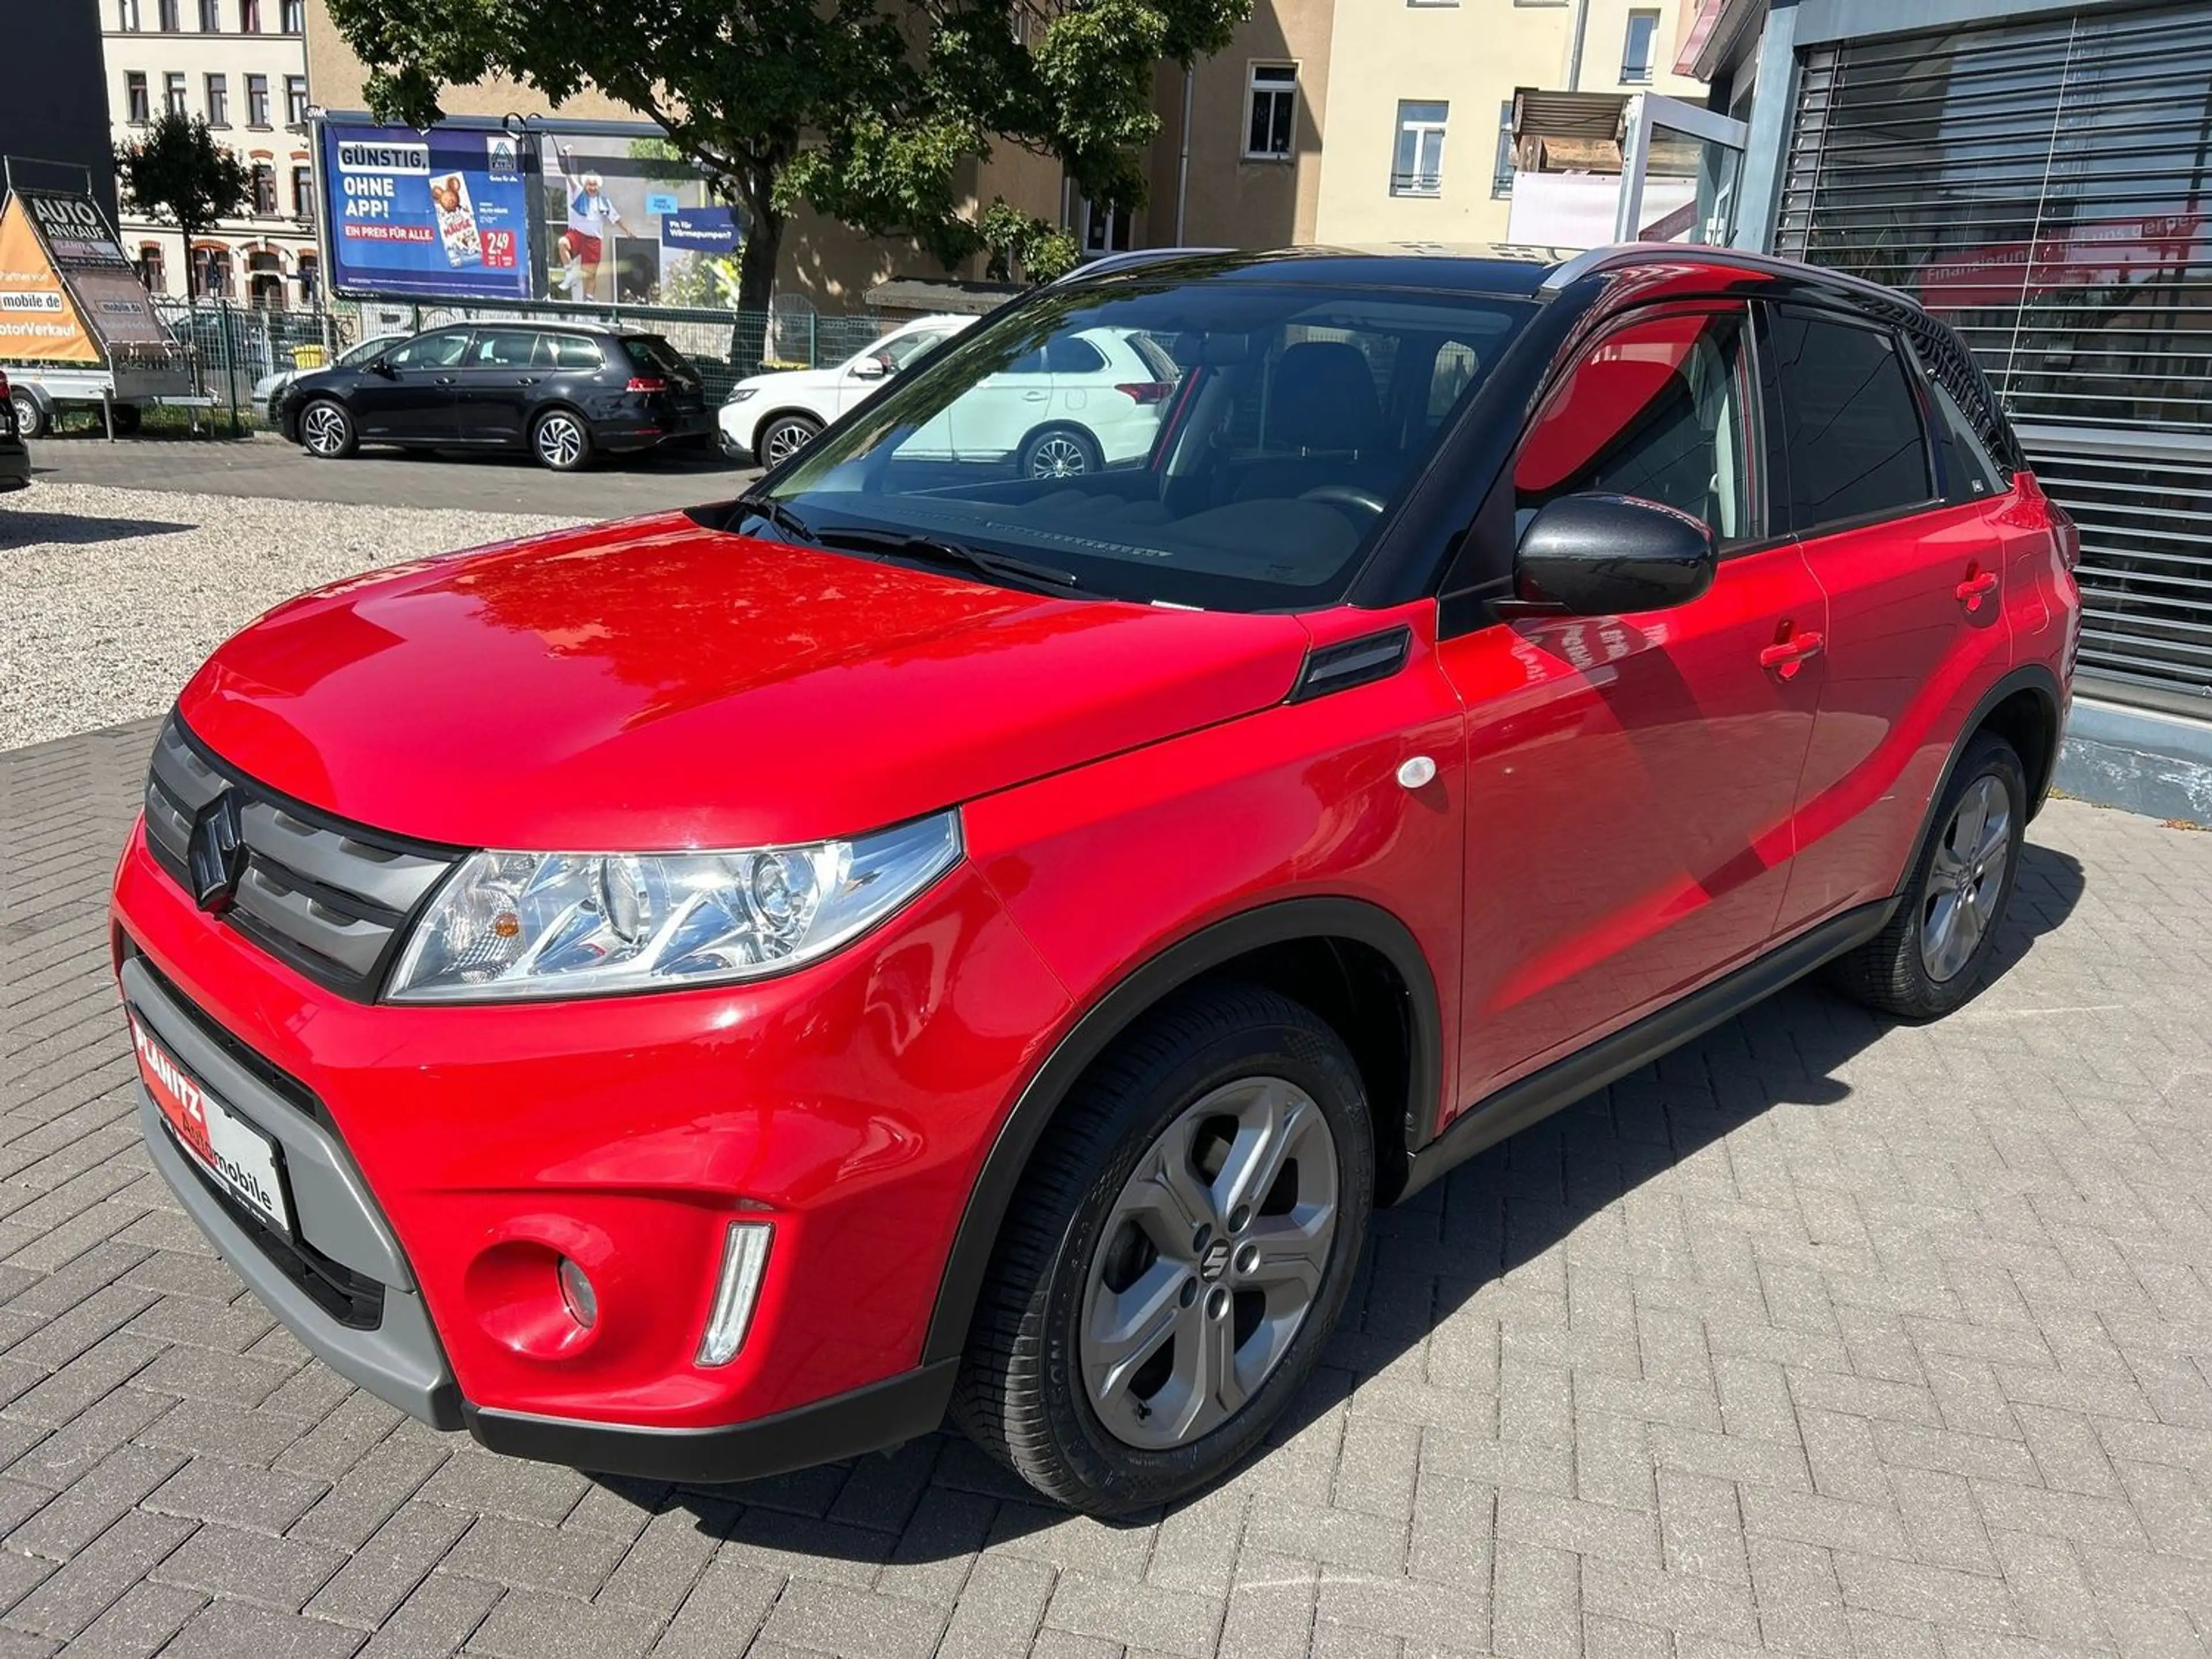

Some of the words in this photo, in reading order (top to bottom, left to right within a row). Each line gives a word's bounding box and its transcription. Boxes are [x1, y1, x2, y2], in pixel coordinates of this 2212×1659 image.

[341, 144, 427, 171] GÜNSTIG,
[344, 176, 395, 197] OHNE
[32, 198, 97, 226] AUTO
[346, 199, 389, 219] APP!
[46, 223, 105, 239] ANKAUF
[346, 225, 360, 237] EIN
[361, 226, 388, 238] PREIS
[389, 226, 407, 240] FÜR
[408, 229, 433, 240] ALLE.
[0, 322, 75, 336] otorVerkauf
[132, 1018, 202, 1123] PLANITZ
[181, 1112, 272, 1211] Automobile
